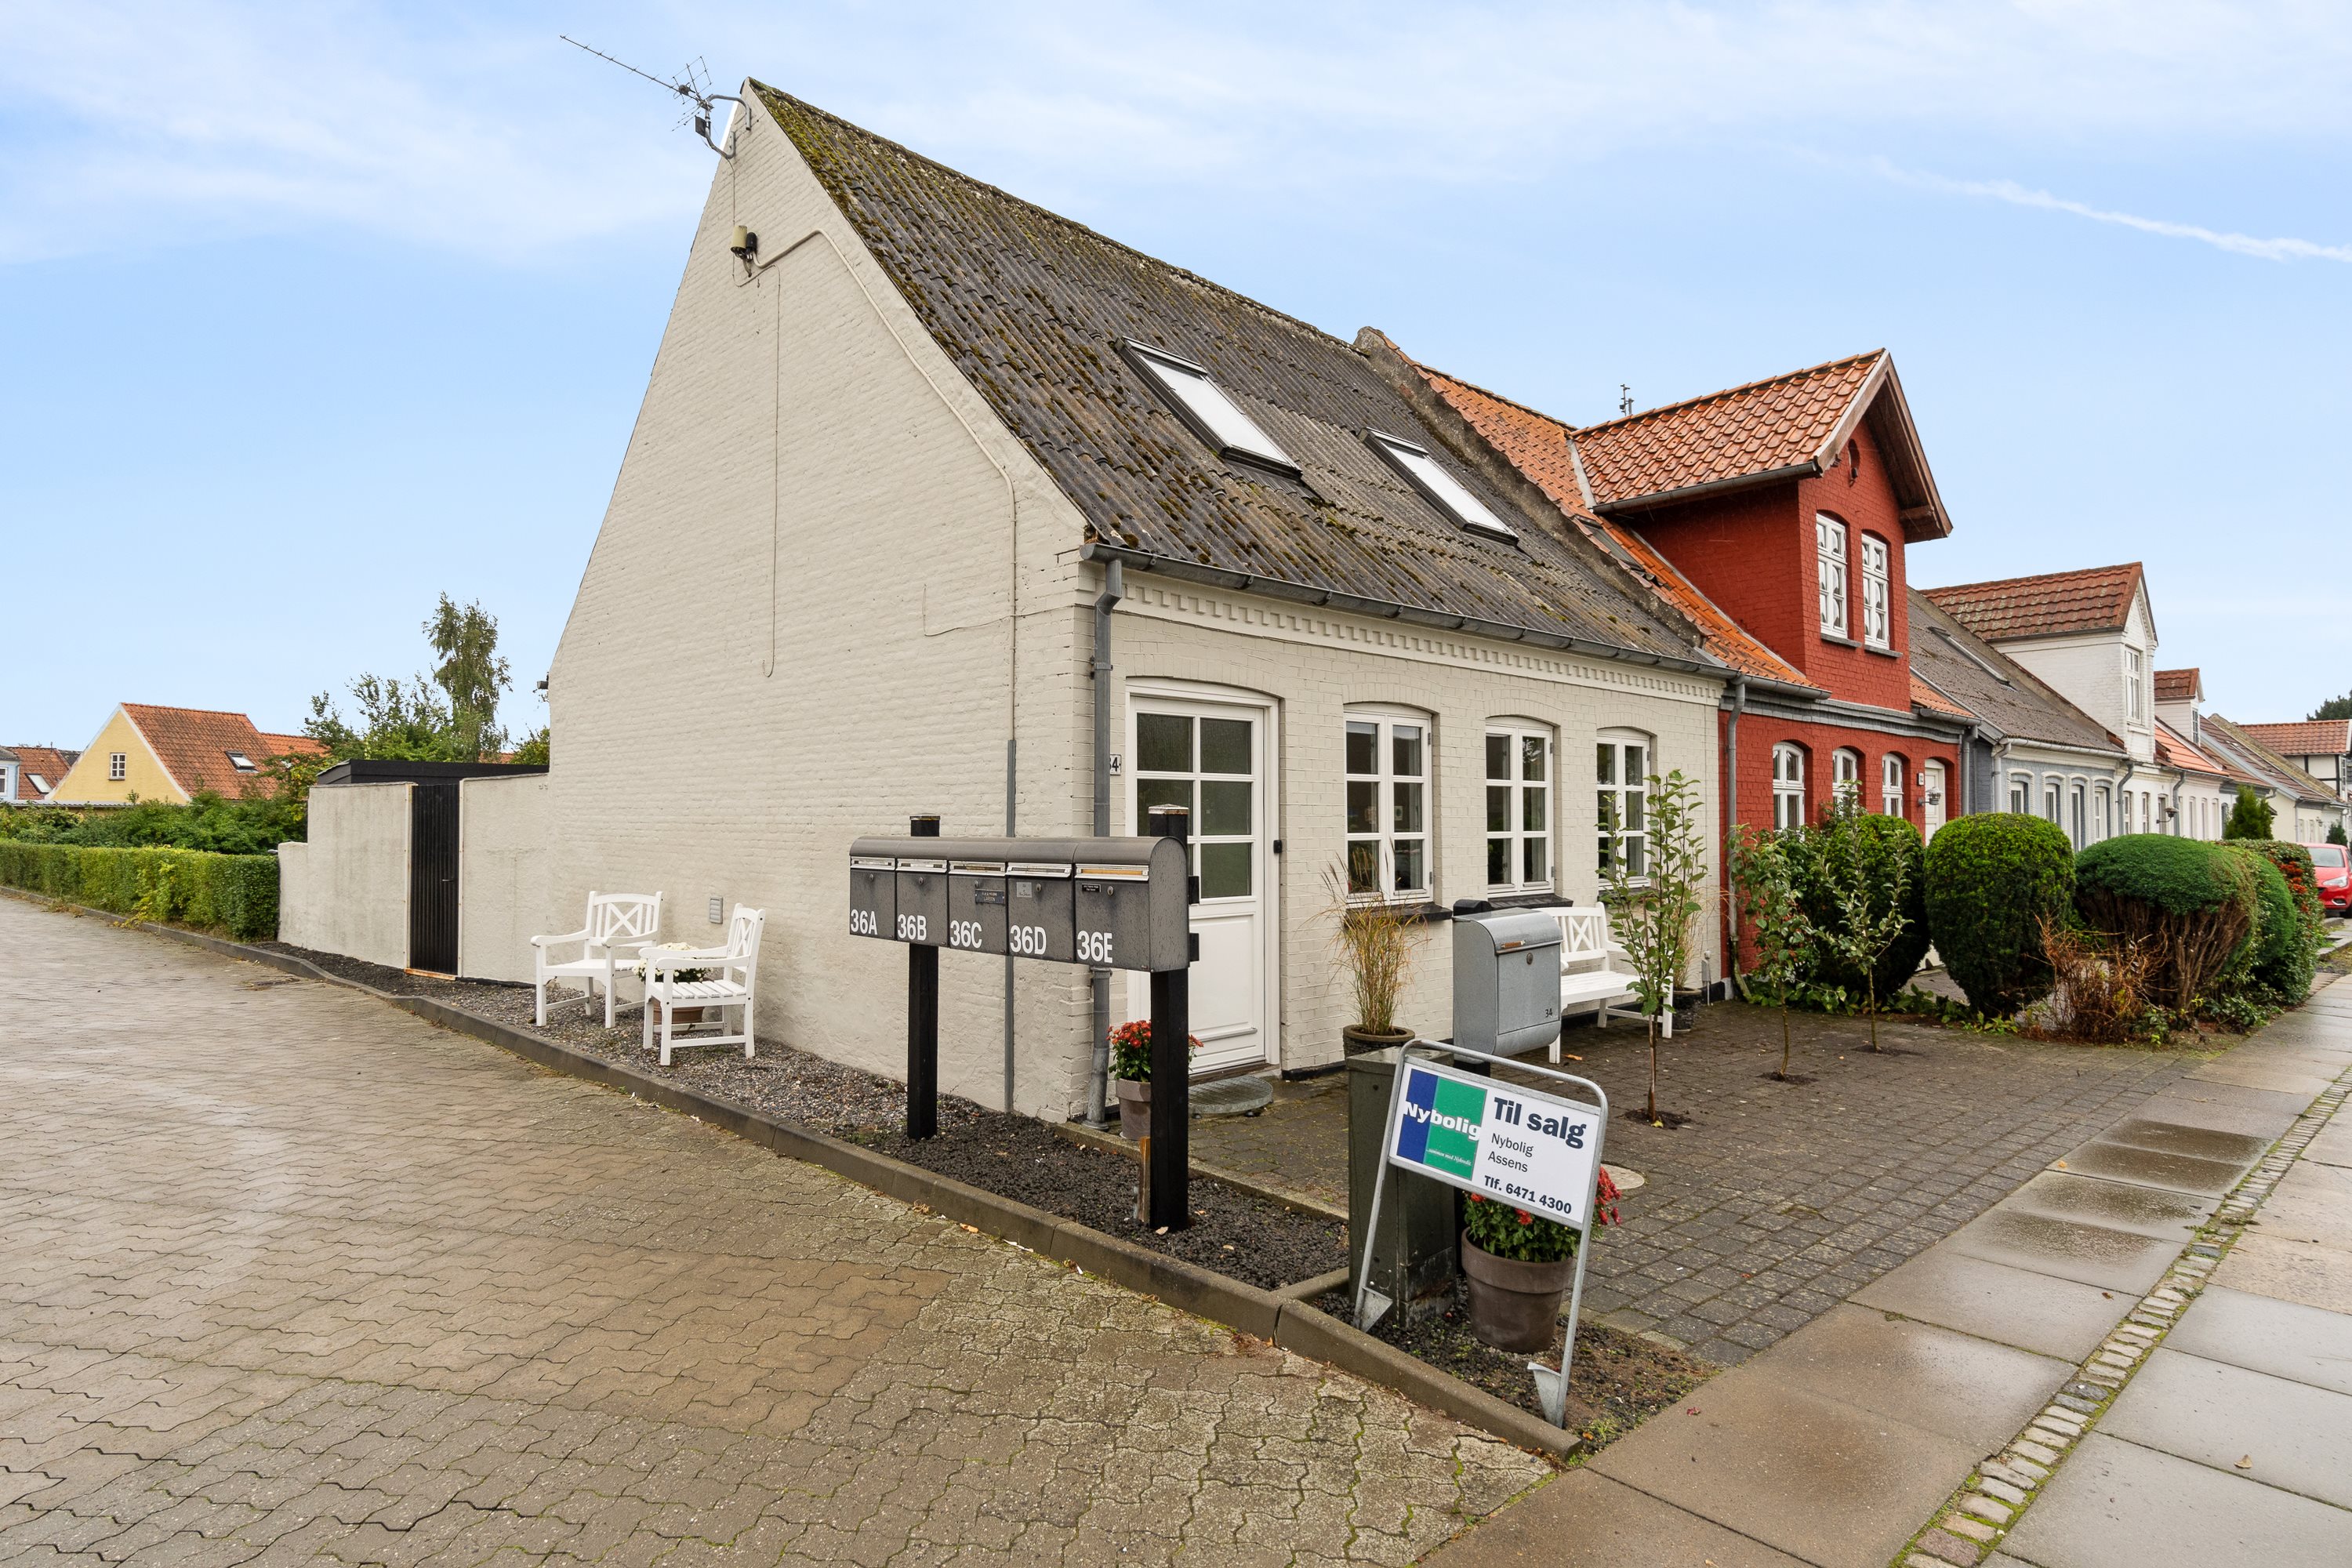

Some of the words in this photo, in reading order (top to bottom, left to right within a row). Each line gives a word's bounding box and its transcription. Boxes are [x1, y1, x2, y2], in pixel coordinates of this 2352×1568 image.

[1109, 757, 1119, 771] 4
[851, 909, 877, 935] 36A
[898, 913, 927, 941] 36B
[950, 920, 982, 949] 36C
[1010, 924, 1047, 955] 36D
[1077, 931, 1113, 964] 36E
[1544, 1007, 1553, 1018] 34
[1403, 1101, 1481, 1141] Nybolig
[1494, 1097, 1523, 1126] Til
[1526, 1112, 1587, 1149] salg
[1491, 1133, 1534, 1158] Nybolig
[1488, 1151, 1528, 1173] Assens
[1484, 1175, 1502, 1191] Tlf.
[1505, 1183, 1535, 1203] 6471
[1539, 1195, 1572, 1214] 4300
